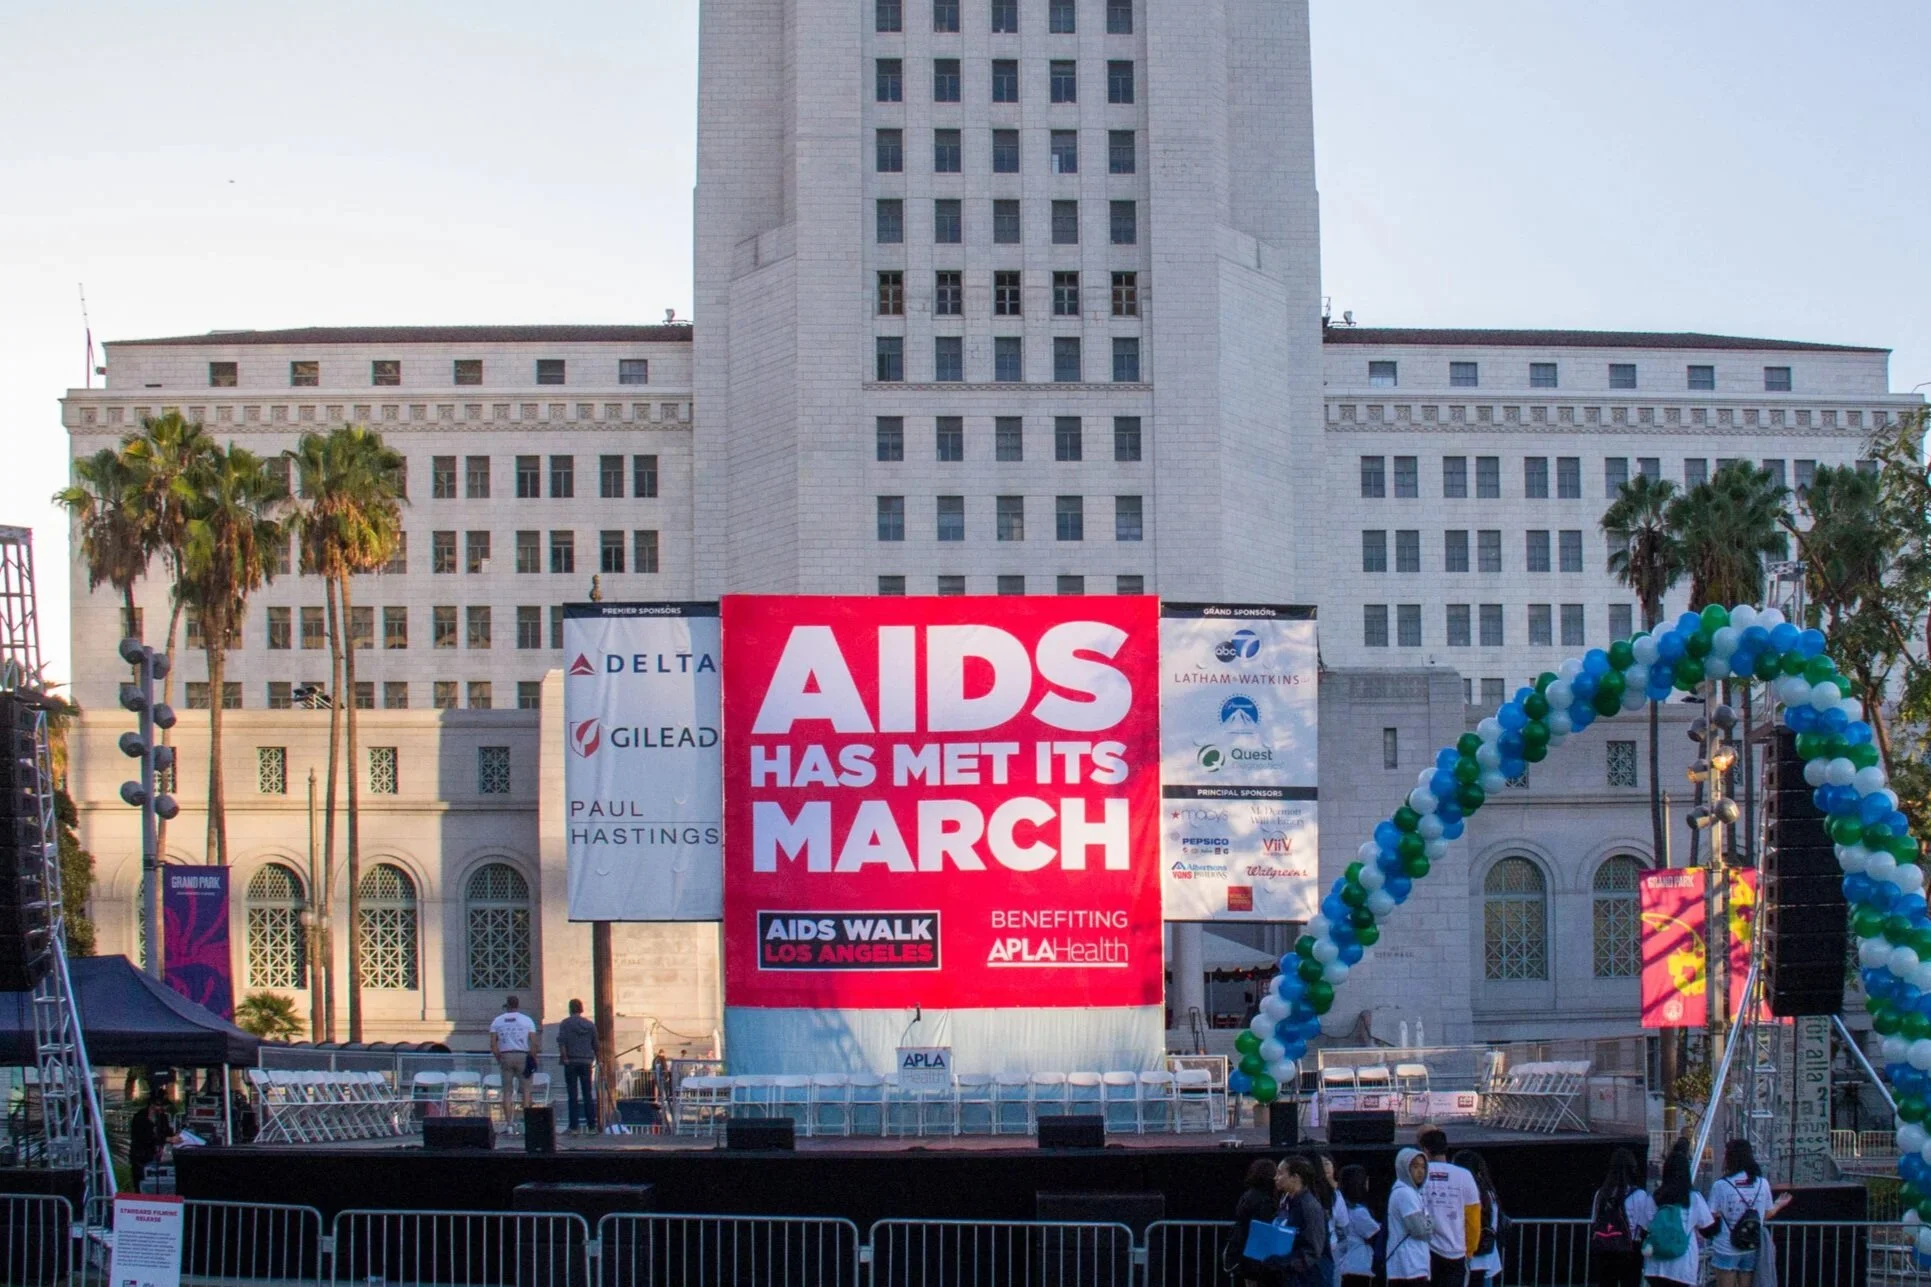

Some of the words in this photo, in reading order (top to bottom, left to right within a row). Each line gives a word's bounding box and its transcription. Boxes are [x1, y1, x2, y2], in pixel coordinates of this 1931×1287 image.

[1203, 608, 1232, 616] GRAND
[1215, 646, 1236, 656] abc
[606, 653, 717, 673] DELTA
[751, 620, 1133, 734] AIDS
[611, 727, 718, 748] GILEAD
[1231, 748, 1273, 761] Quest
[750, 743, 877, 787] HAS
[893, 742, 1019, 786] MET
[1036, 741, 1129, 785] ITS
[1197, 788, 1239, 797] PRINCIPAL
[1240, 789, 1283, 797] SPONSORS
[571, 800, 644, 817] PAUL
[571, 827, 720, 845] HASTINGS
[752, 796, 1130, 872] MARCH
[1182, 838, 1229, 846] PEPSICO
[1263, 838, 1292, 852] ViiV
[171, 876, 199, 889] GRAND
[199, 876, 221, 889] PARK
[1172, 870, 1192, 880] VONS
[991, 910, 1128, 929] BENEFITING
[765, 919, 837, 941] AIDS
[843, 918, 933, 941] WALK
[765, 944, 812, 963] LOS
[818, 943, 934, 963] ANGELES
[903, 1053, 945, 1067] APLA
[1805, 1049, 1829, 1083] alla
[903, 1070, 946, 1084] Health
[120, 1207, 152, 1216] STANDARD
